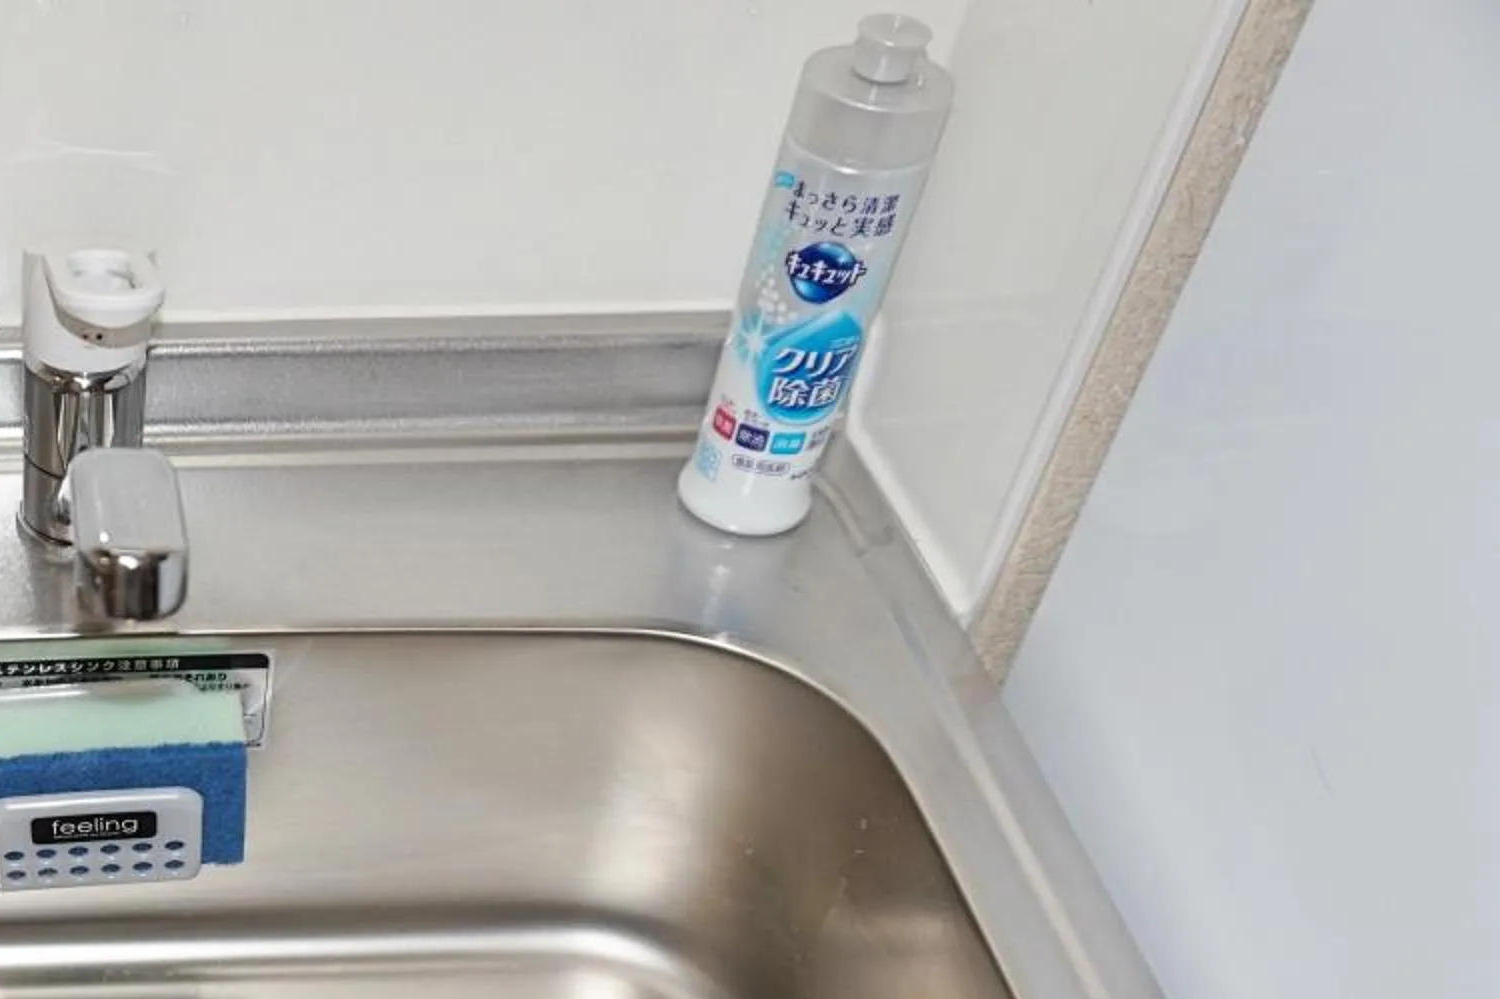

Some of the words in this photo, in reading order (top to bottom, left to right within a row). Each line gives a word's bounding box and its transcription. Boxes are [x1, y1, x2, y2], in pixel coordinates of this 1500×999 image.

[784, 199, 897, 238] キュッと実感
[785, 250, 868, 288] キュキュット
[771, 344, 858, 378] クリア
[767, 375, 844, 407] 除菌
[52, 816, 138, 835] feeling
